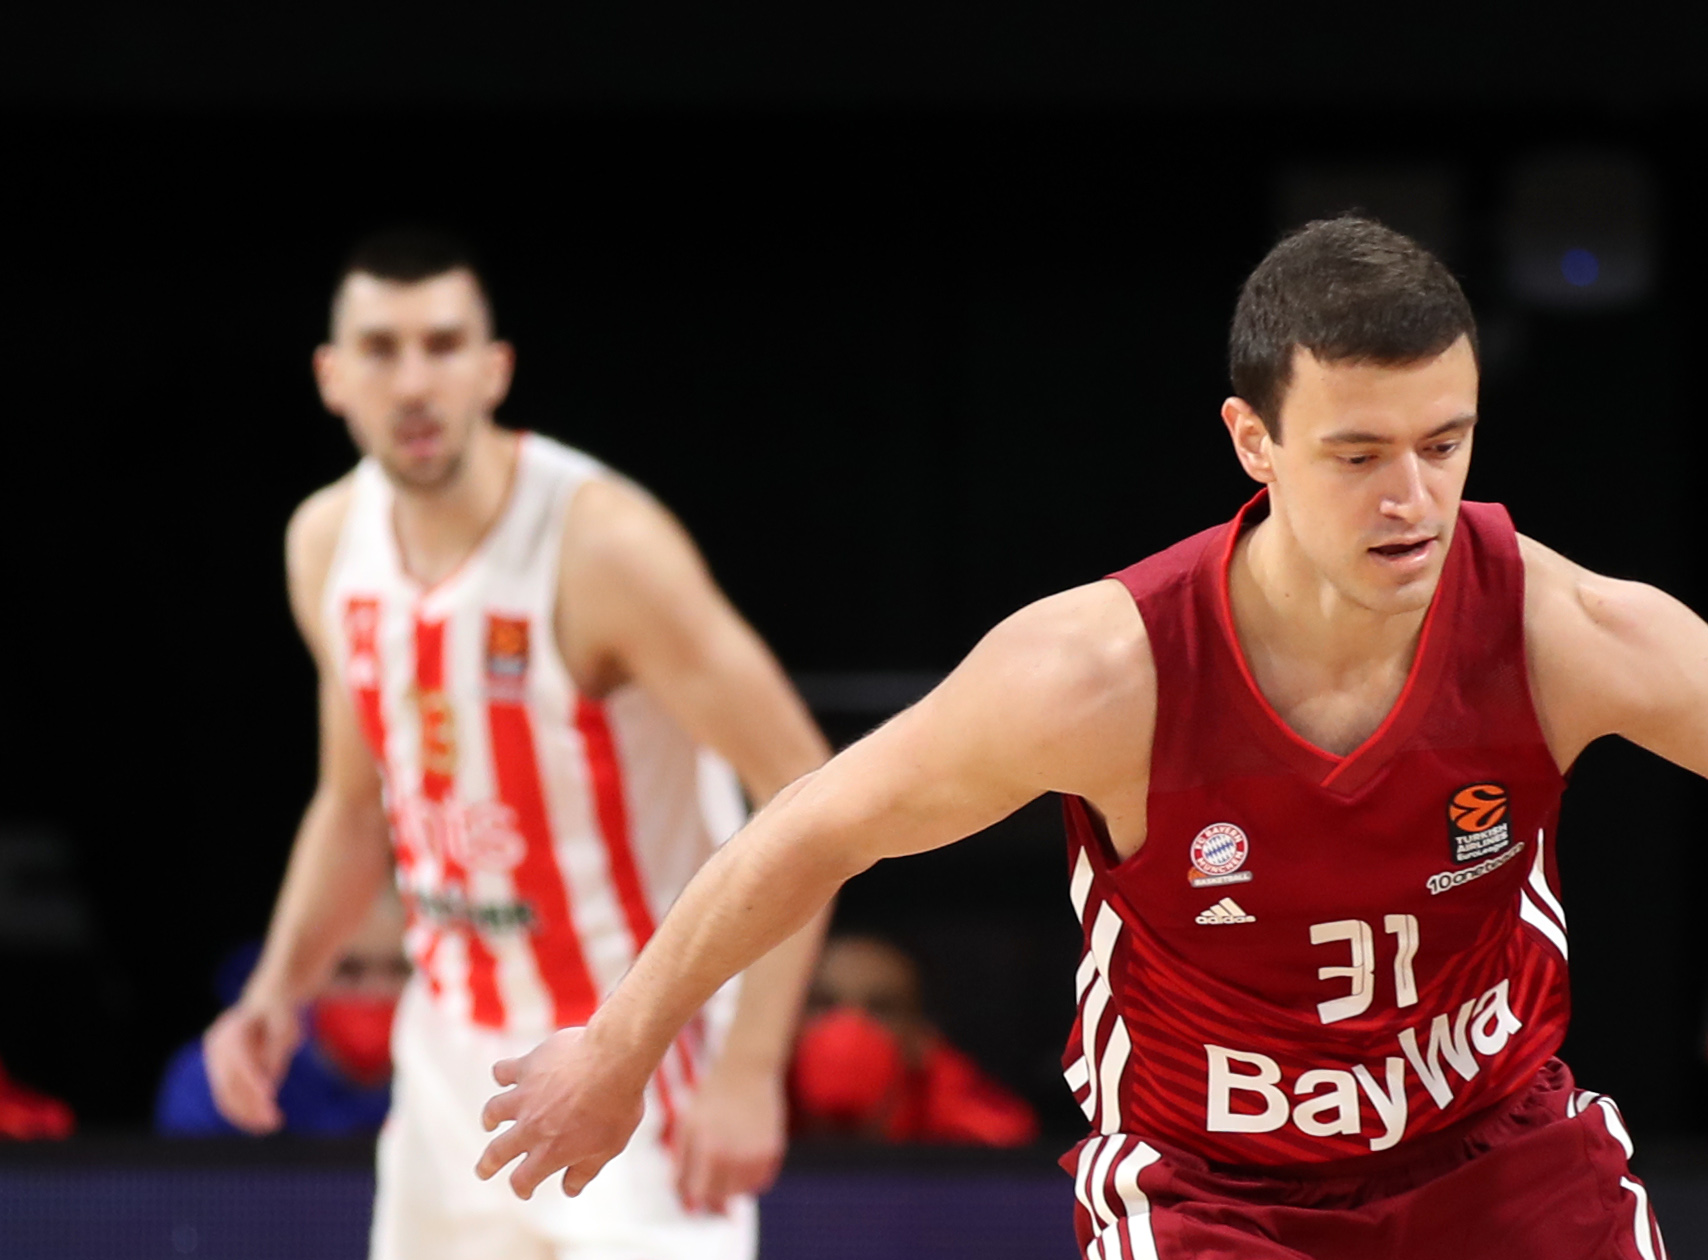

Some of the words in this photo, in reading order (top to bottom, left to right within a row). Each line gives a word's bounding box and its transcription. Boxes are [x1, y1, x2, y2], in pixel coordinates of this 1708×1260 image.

[1455, 823, 1508, 845] TURKISH
[1456, 831, 1509, 853] AIRLINES
[1309, 914, 1419, 1025] 31
[1204, 979, 1522, 1151] BayWa
